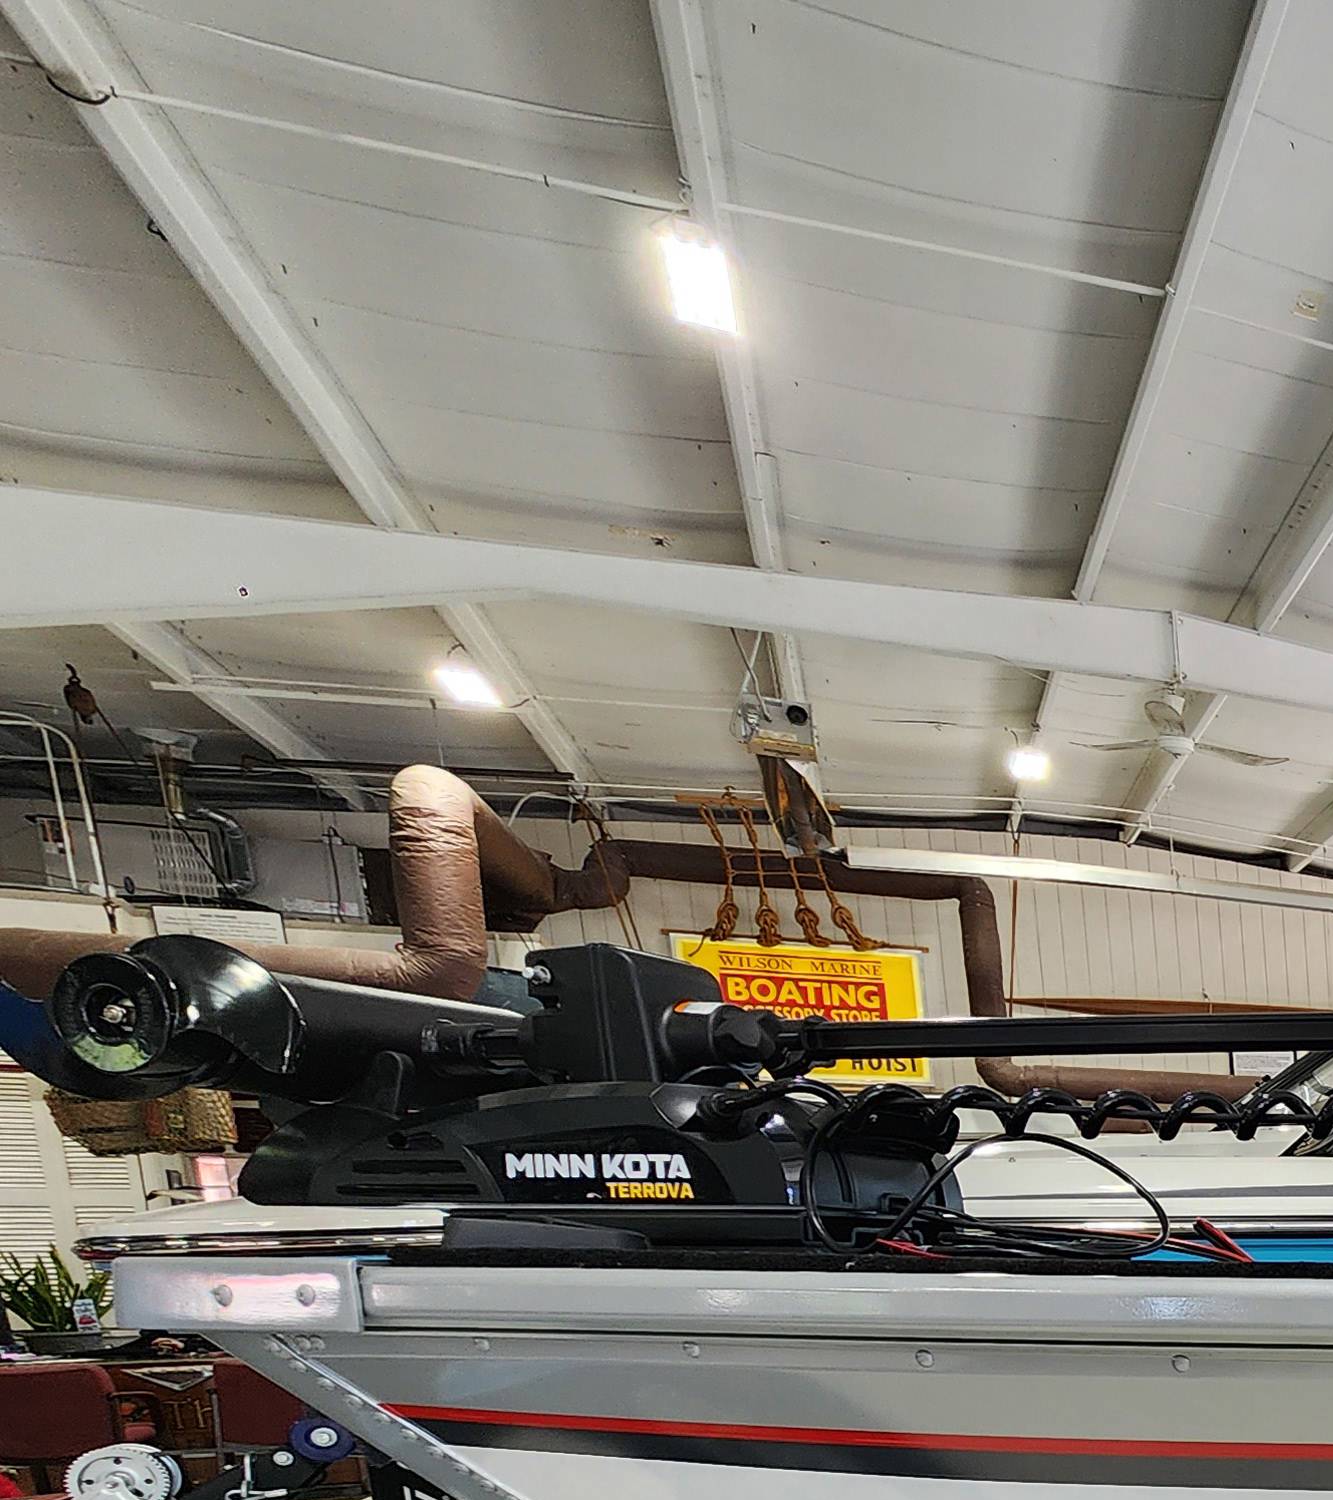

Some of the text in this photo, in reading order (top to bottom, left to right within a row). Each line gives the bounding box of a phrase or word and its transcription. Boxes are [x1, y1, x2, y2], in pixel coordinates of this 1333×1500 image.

[719, 954, 883, 976] WILSON MARINE
[726, 976, 881, 1009] BOATING
[504, 1152, 692, 1179] MINN KOTA
[605, 1181, 695, 1199] TERROVA
